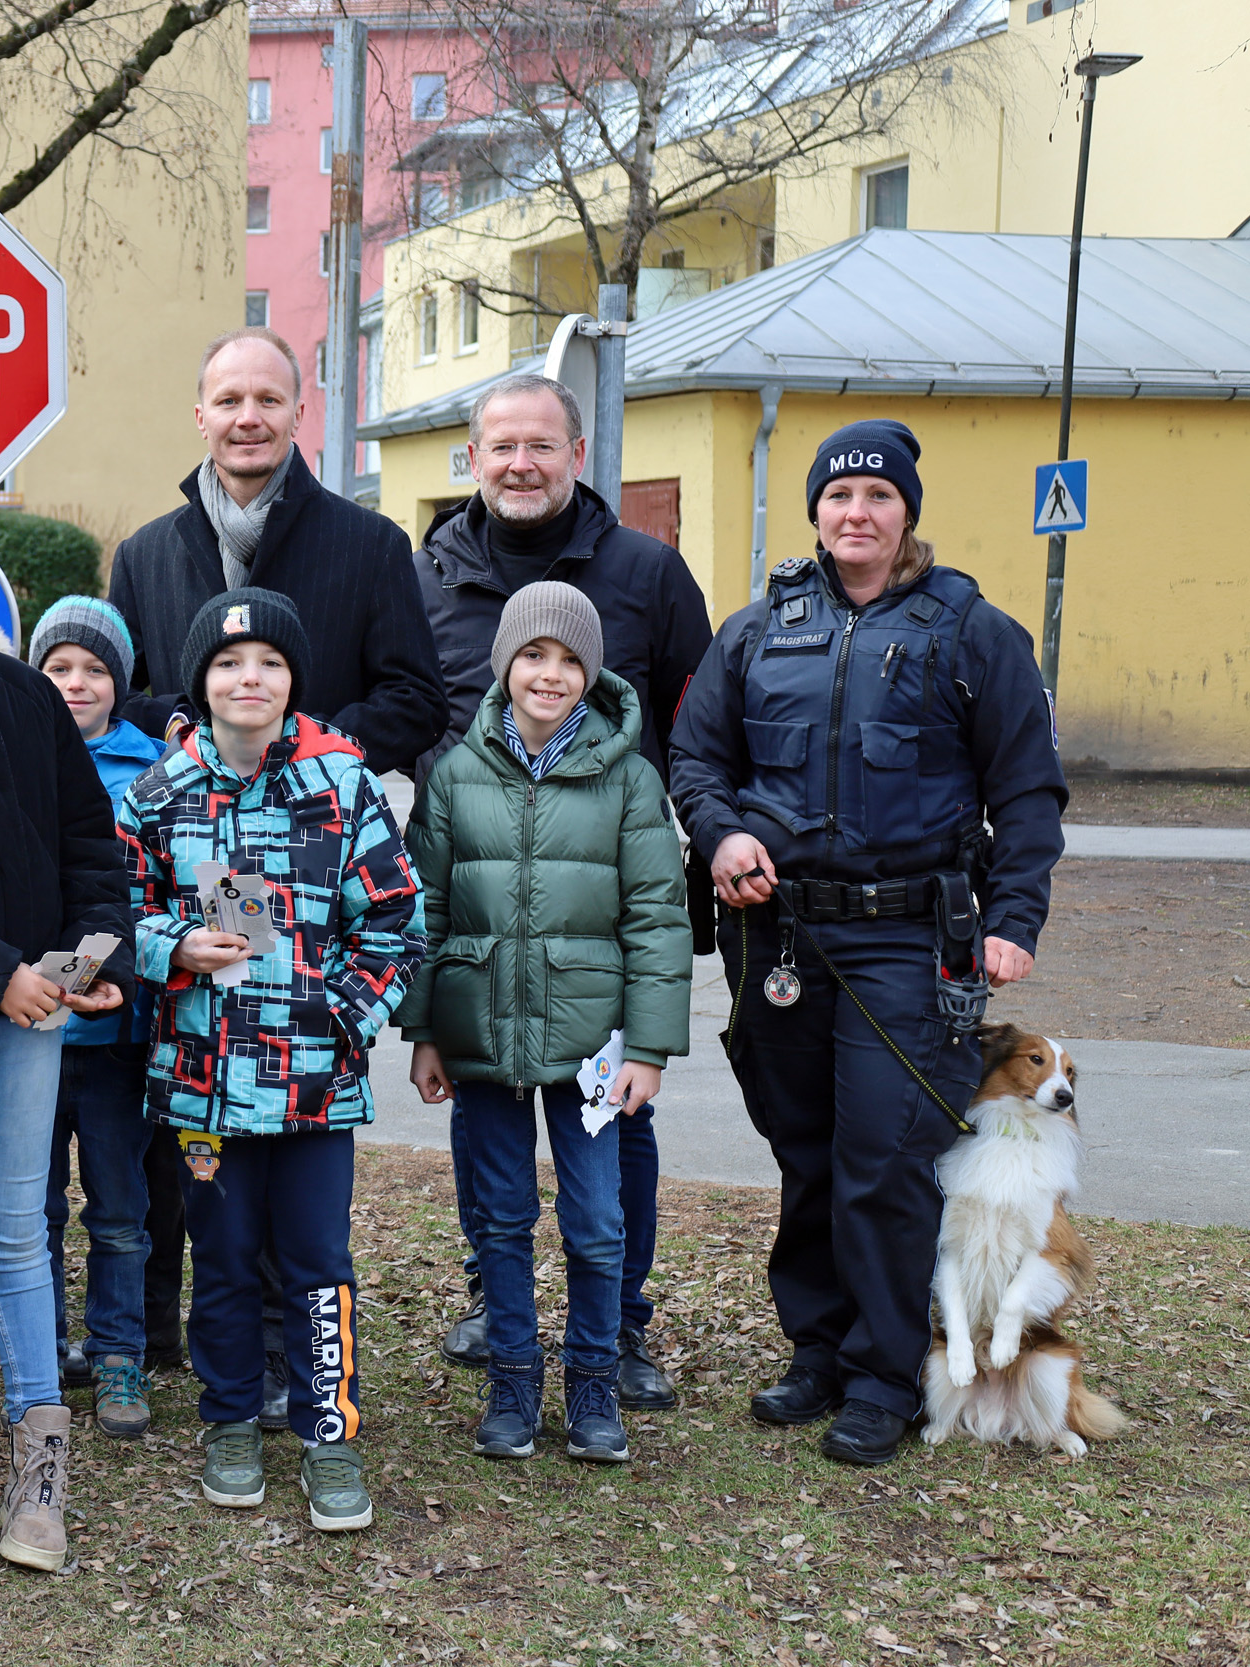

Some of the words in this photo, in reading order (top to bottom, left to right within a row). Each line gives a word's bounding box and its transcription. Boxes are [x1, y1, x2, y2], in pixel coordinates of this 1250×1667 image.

[830, 449, 883, 473] MÜG
[772, 633, 824, 646] MAGISTRAT
[308, 1286, 344, 1442] NARUTO
